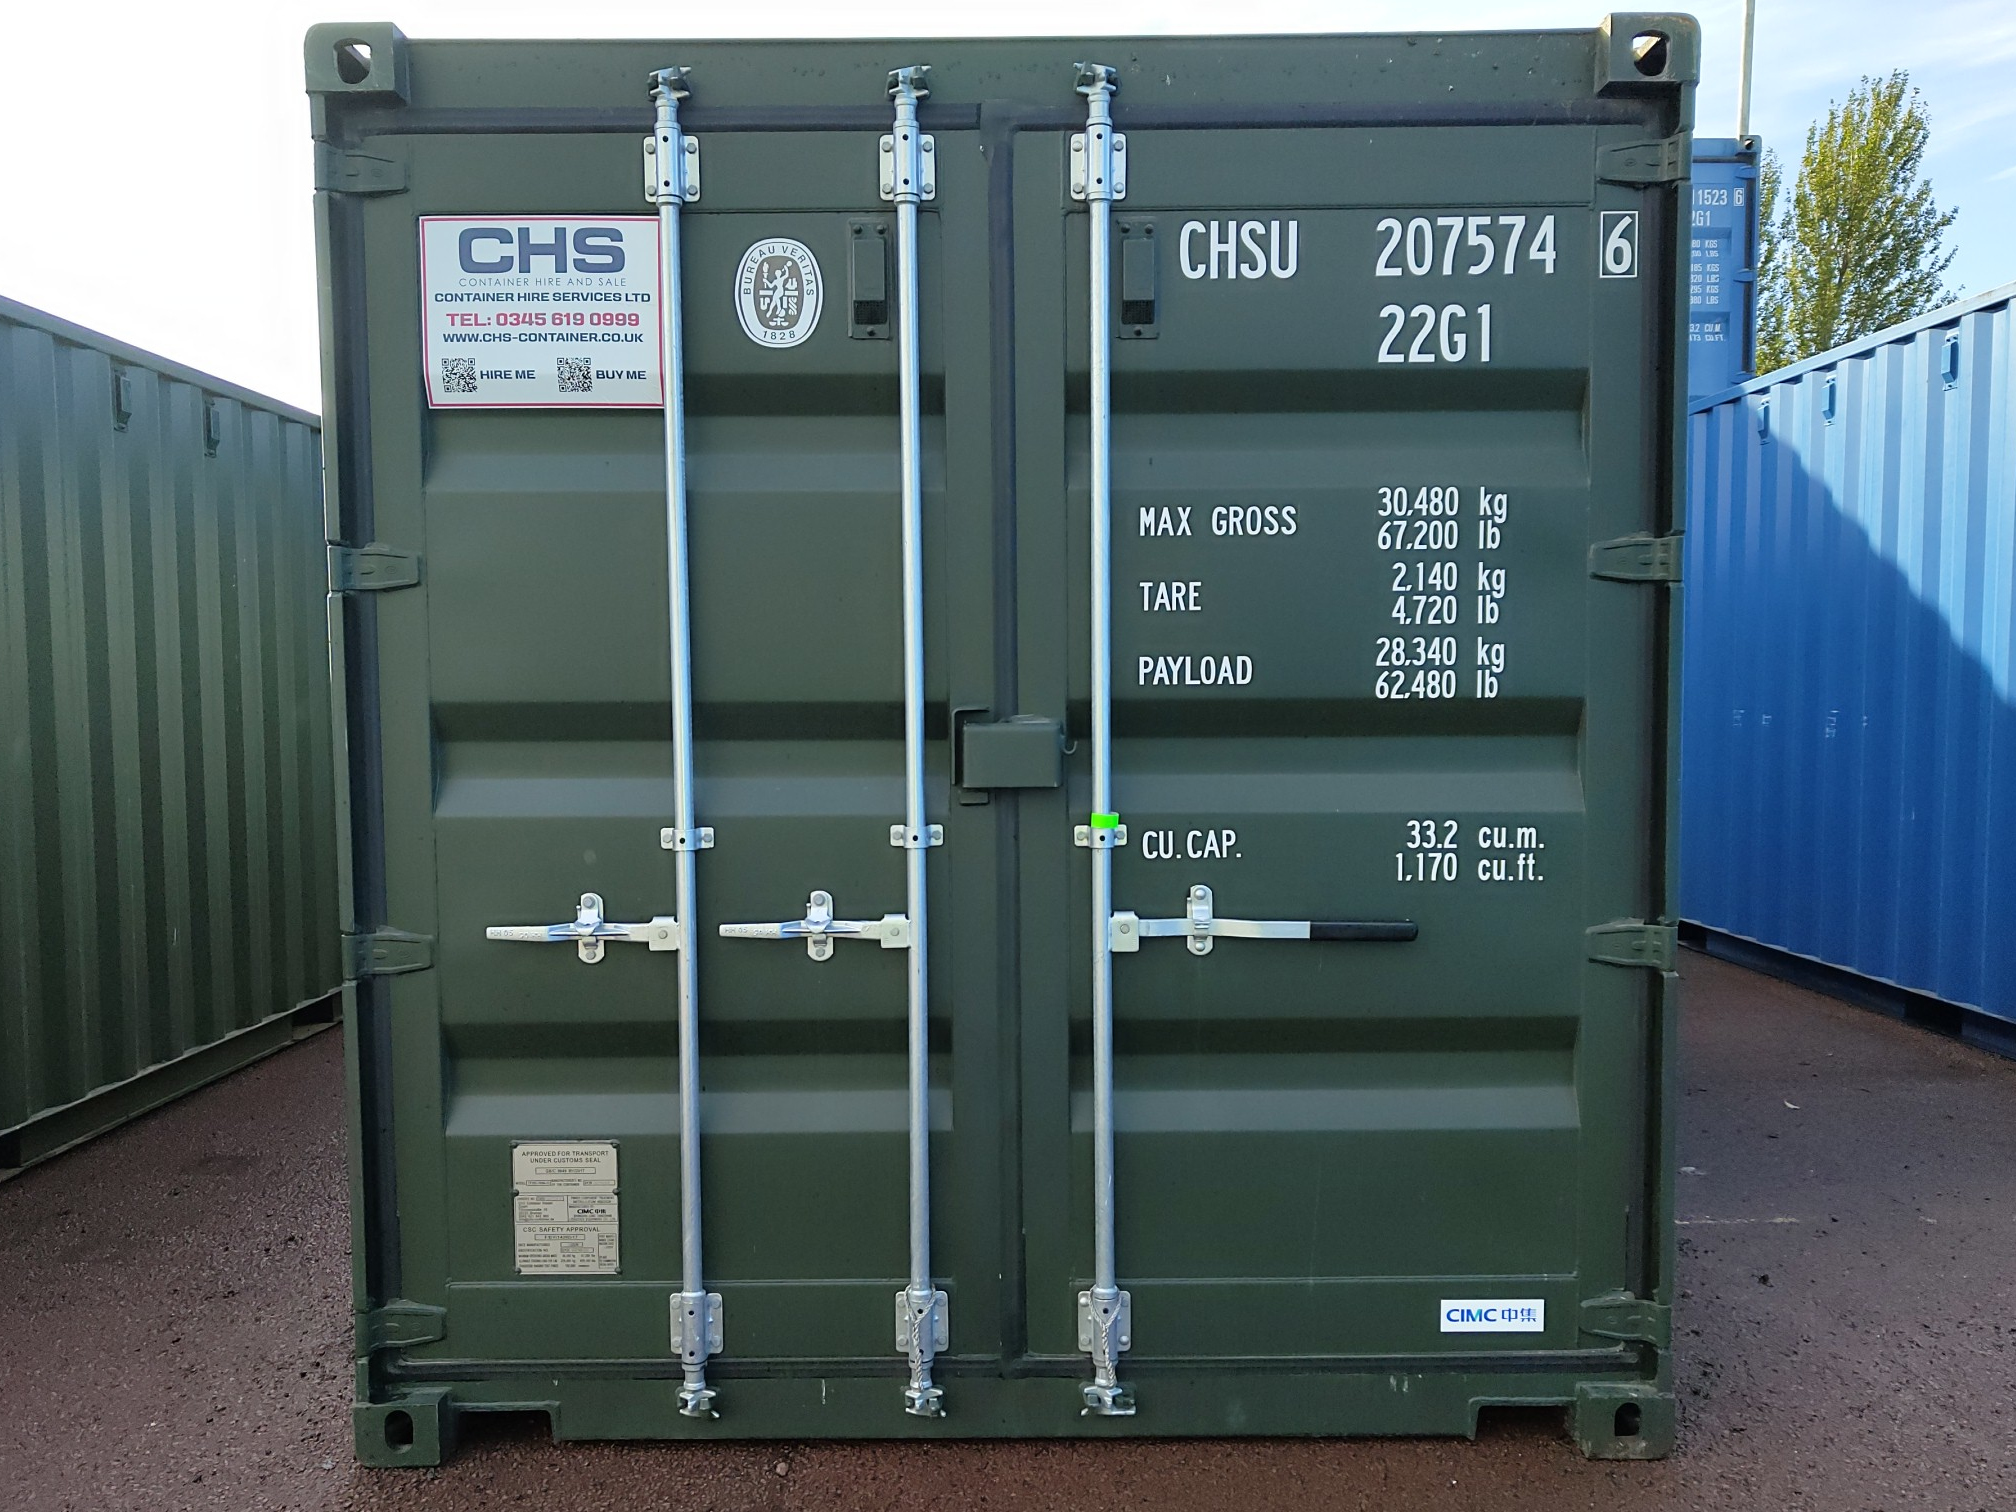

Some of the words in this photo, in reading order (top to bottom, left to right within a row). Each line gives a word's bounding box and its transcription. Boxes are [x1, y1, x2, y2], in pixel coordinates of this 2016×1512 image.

[458, 226, 627, 274] CHS
[1178, 219, 1299, 281] CHSU
[1375, 214, 1557, 278] 207574
[1605, 215, 1633, 274] 6
[1704, 239, 1718, 249] KGS
[743, 245, 776, 296] BUREAU
[781, 245, 815, 296] VERITAS
[1706, 263, 1720, 272] KGS
[1706, 274, 1720, 283] LBS
[458, 277, 529, 288] CONTAINER
[535, 277, 562, 288] HIRE
[567, 277, 594, 287] AND
[598, 277, 627, 288] SALE
[1706, 284, 1719, 294] KGS
[434, 292, 514, 303] CONTAINER
[517, 292, 550, 303] HIRE
[552, 292, 623, 303] SERVICES
[625, 292, 651, 303] LTD
[1706, 295, 1719, 305] LBS
[445, 312, 492, 327] TEL:
[496, 312, 547, 327] 0345
[551, 312, 585, 327] 619
[589, 312, 640, 327] 0999
[1377, 303, 1492, 364] 22G1
[442, 331, 644, 344] WWW.CHS-CONTAINER.CO.UK
[763, 329, 797, 341] 1828
[480, 369, 513, 380] HIRE
[515, 369, 536, 380] ME
[595, 369, 624, 380] BUY
[627, 369, 647, 380] ME
[1377, 486, 1459, 517] 30,480
[1478, 486, 1508, 525] kg
[1139, 506, 1192, 537] MAX
[1211, 505, 1297, 536] GROSS
[1377, 520, 1459, 550] 67,200
[1478, 519, 1501, 550] lb
[1391, 561, 1458, 592] 2,140
[1477, 561, 1506, 599] kg
[1139, 581, 1202, 612] TARE
[1391, 595, 1457, 625] 4,720
[1476, 595, 1500, 625] lb
[1375, 636, 1457, 667] 28,340
[1476, 636, 1505, 674] kg
[1138, 655, 1253, 686] PAYLOAD
[1375, 669, 1457, 699] 62,480
[1476, 669, 1499, 699] lb
[1406, 820, 1458, 849] 33.2
[1478, 826, 1546, 849] cu.m.
[1395, 852, 1458, 882] 1,170
[1477, 852, 1544, 882] cu.ft.
[1446, 1308, 1497, 1323] CIMC
[1501, 1307, 1537, 1323] 中集
